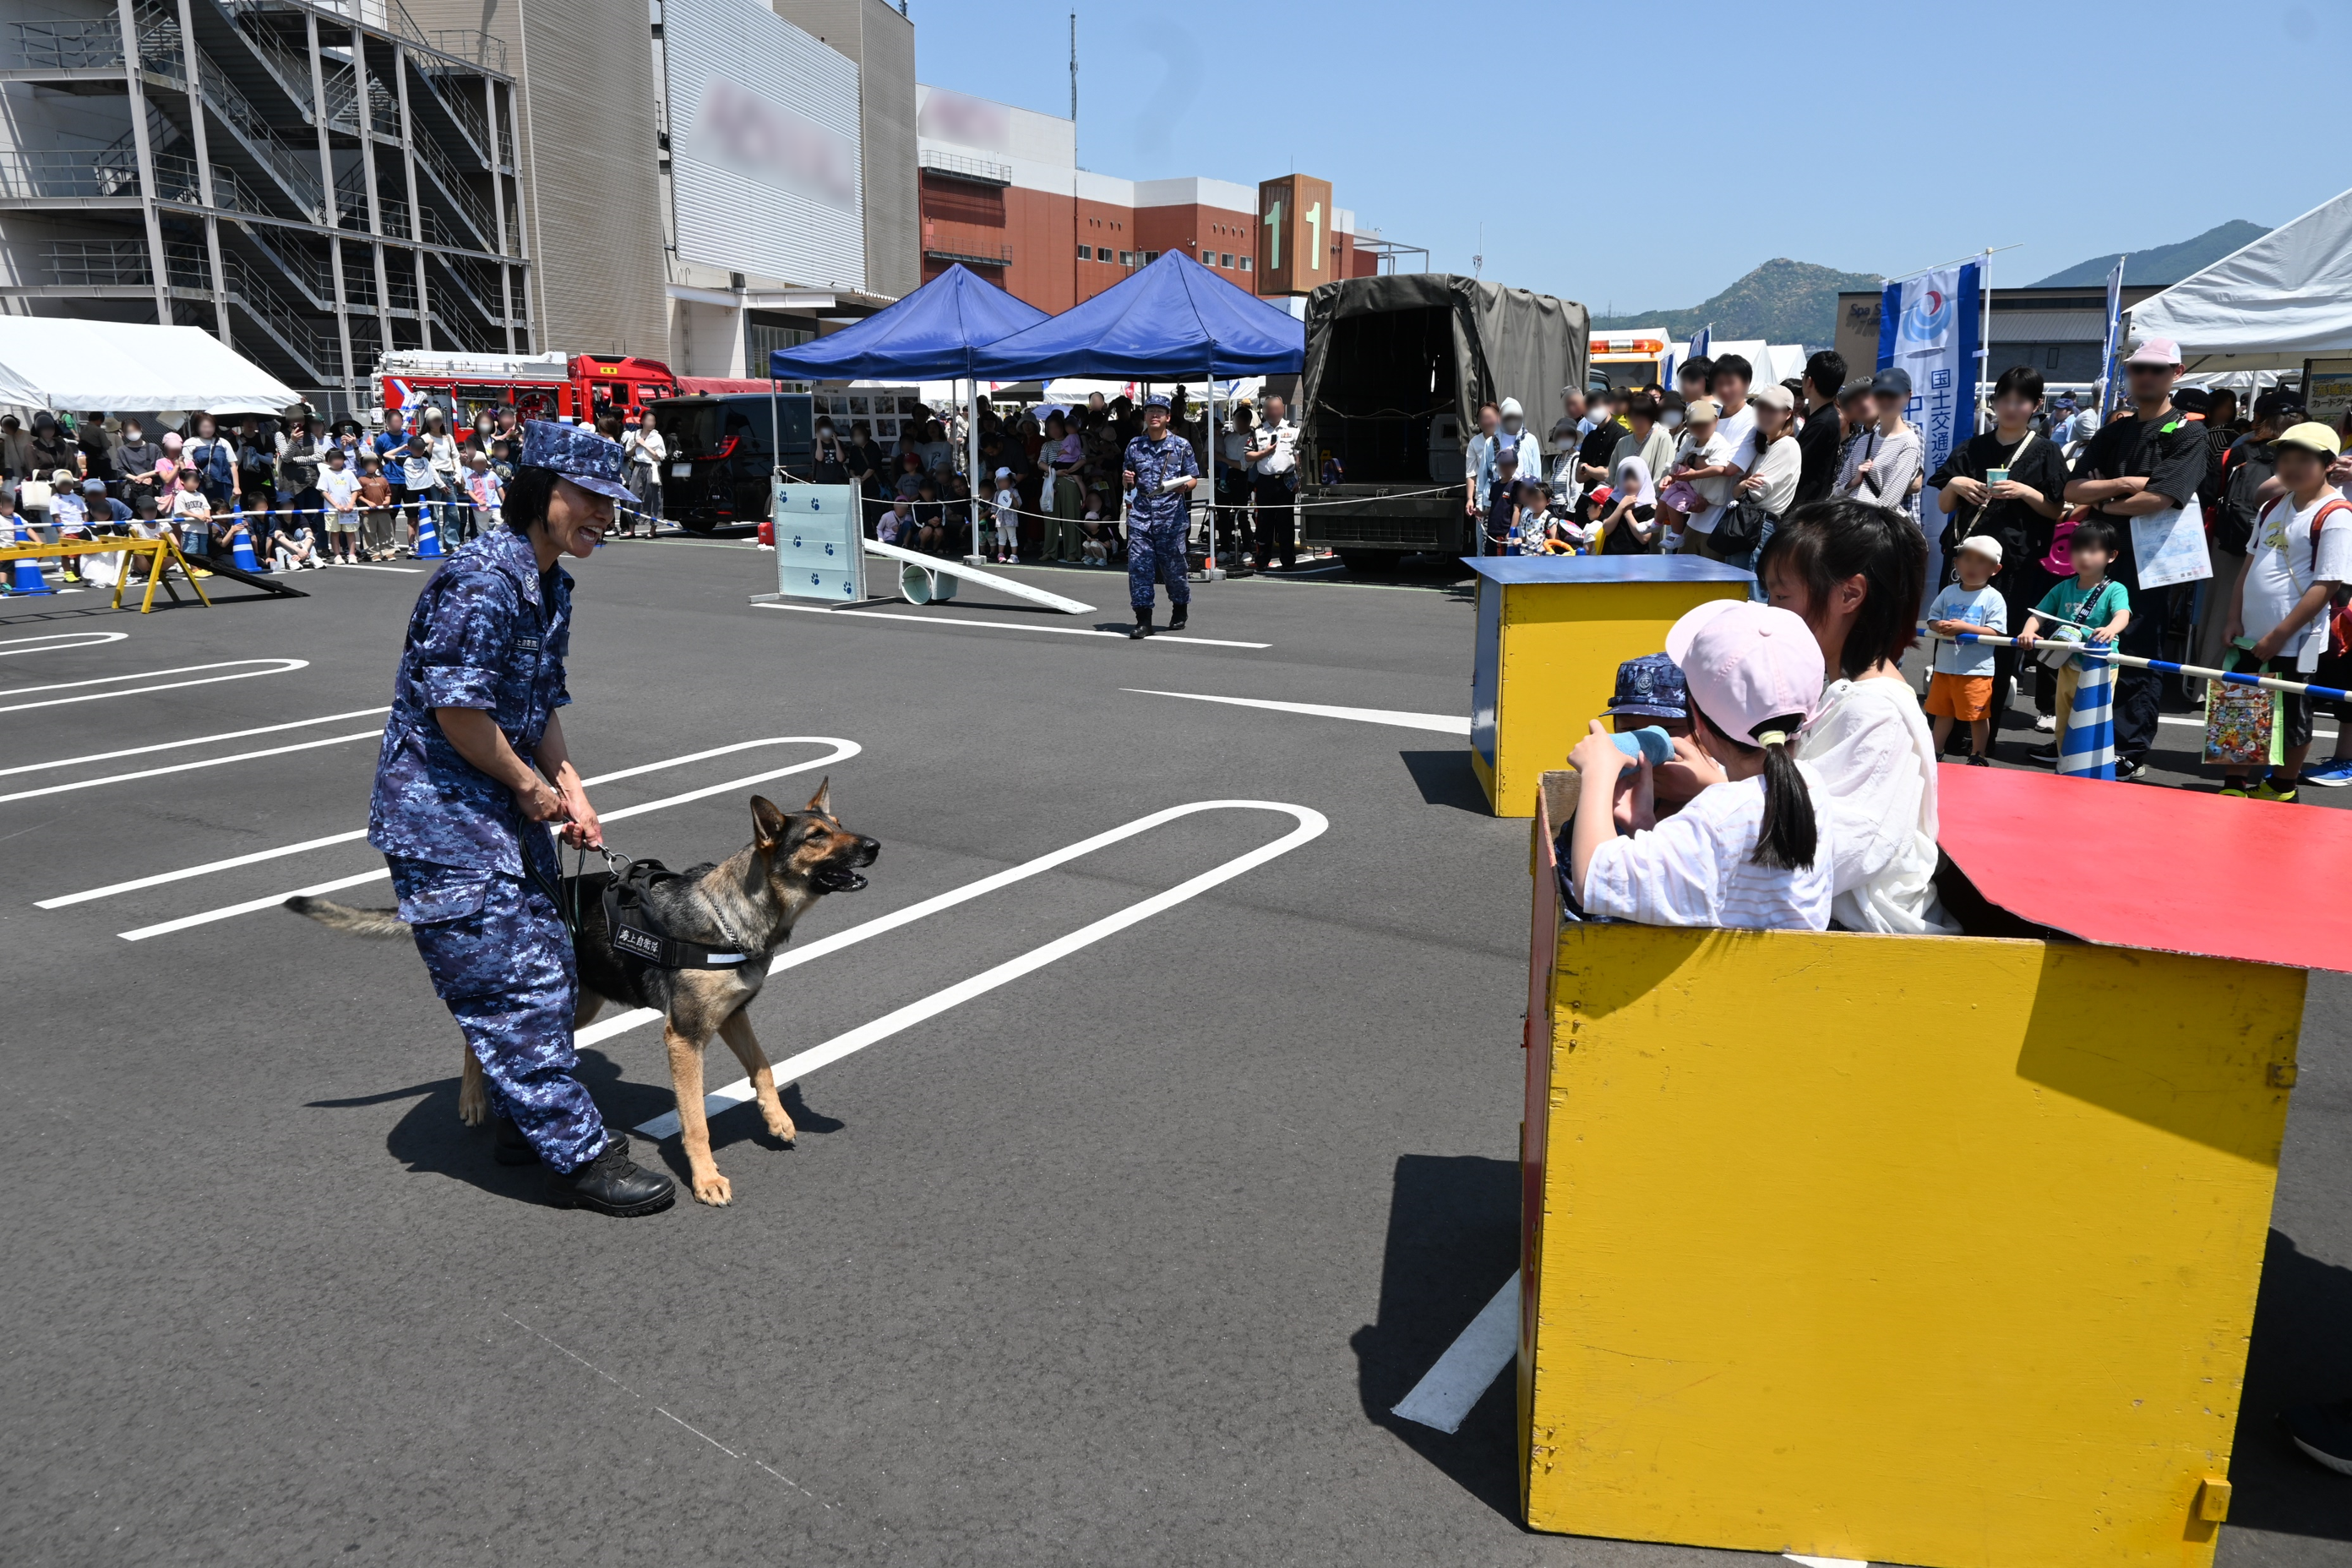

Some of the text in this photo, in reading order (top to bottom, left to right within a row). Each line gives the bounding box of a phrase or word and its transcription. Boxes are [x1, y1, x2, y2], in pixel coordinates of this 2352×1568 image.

[1265, 201, 1280, 270] 1
[1305, 201, 1320, 270] 1
[1850, 303, 1870, 318] Spa
[1931, 368, 1951, 471] 国土交通省
[618, 929, 658, 952] 海上自衛隊
